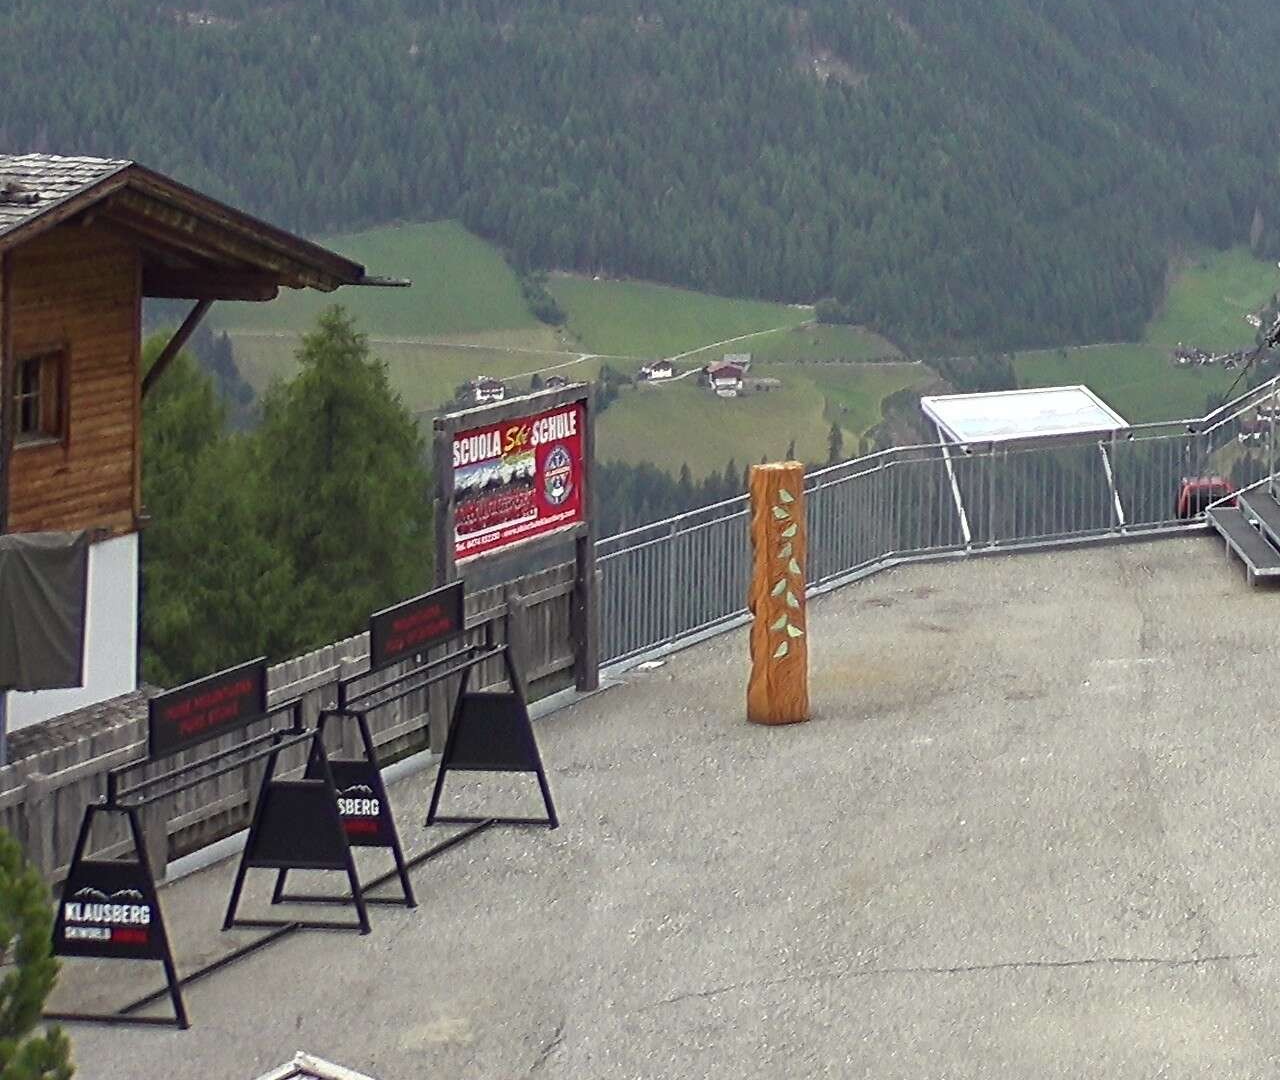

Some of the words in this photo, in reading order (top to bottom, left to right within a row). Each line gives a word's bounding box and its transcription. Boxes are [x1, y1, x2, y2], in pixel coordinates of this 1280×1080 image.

[453, 430, 501, 467] SCUOLA
[530, 410, 577, 446] SCHULE
[337, 798, 380, 816] SBERG
[65, 903, 150, 924] KLAUSBERG
